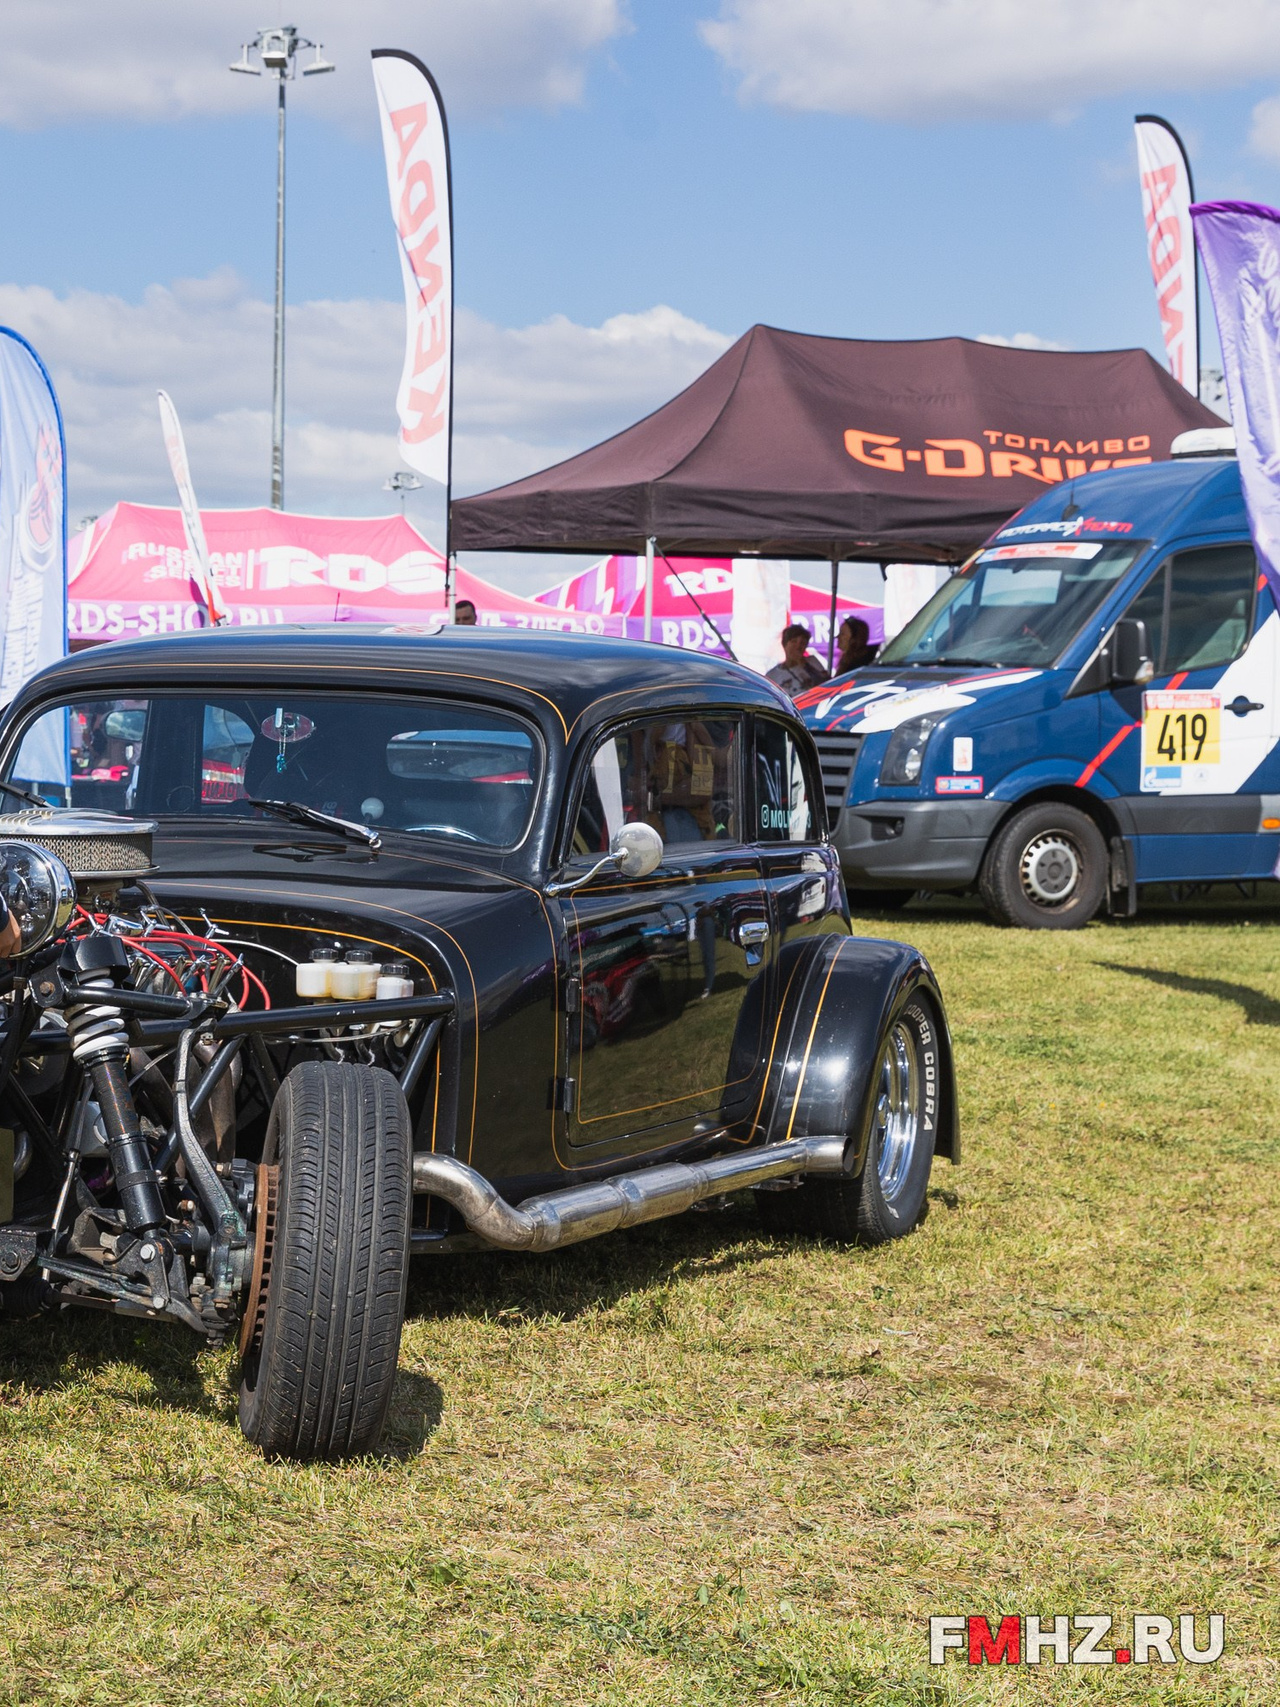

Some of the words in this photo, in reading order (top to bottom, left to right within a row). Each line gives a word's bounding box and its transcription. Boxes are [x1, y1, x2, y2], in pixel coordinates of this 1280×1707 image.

[983, 430, 1151, 454] ТОПЛИВО
[128, 542, 243, 566] RUSSAN
[259, 545, 448, 594] RDS
[664, 567, 733, 597] RD
[1158, 713, 1207, 761] 419
[904, 1003, 931, 1045] COOPER
[923, 1051, 935, 1131] COBRA
